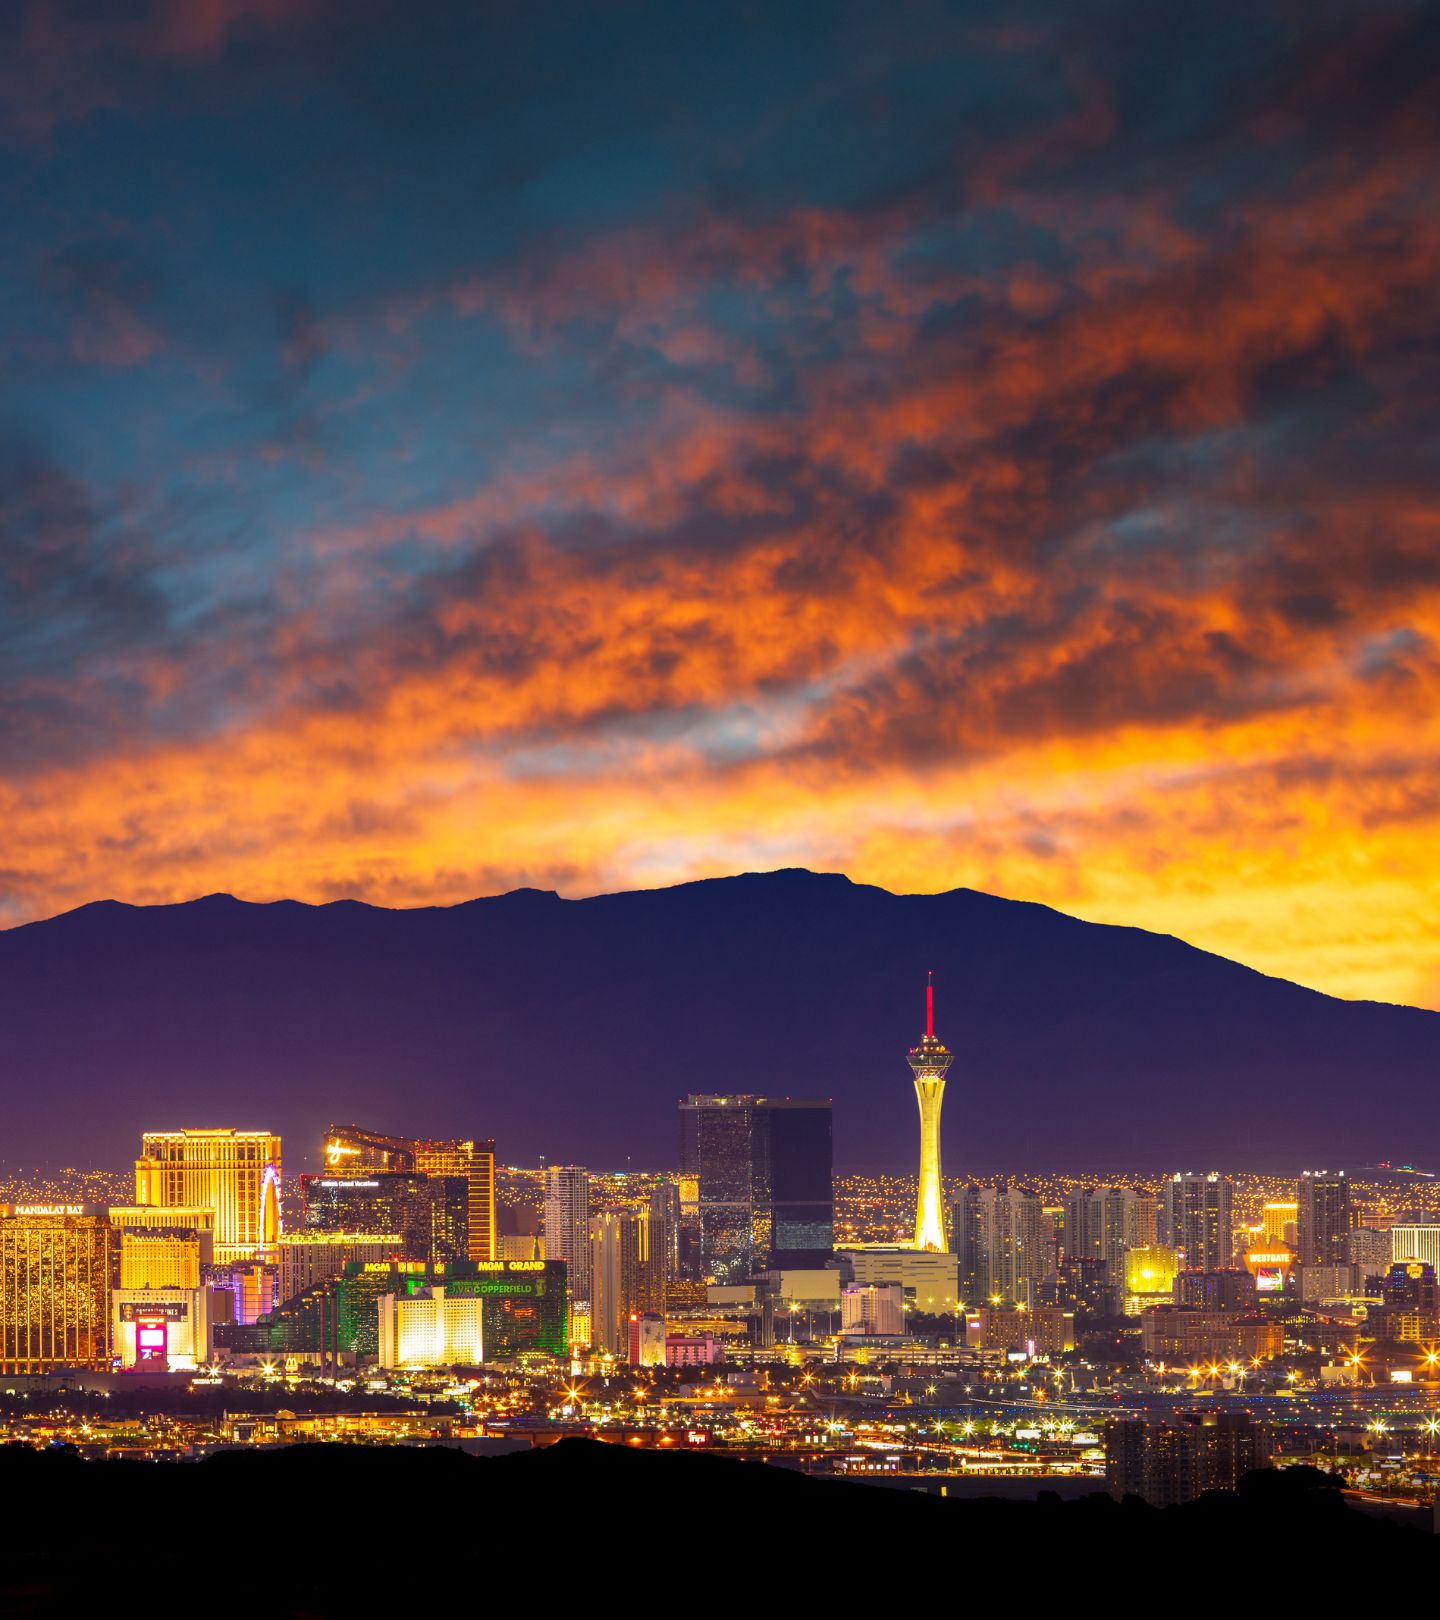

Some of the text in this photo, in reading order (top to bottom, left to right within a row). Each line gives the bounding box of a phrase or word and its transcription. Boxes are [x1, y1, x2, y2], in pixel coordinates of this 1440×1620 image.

[15, 1205, 84, 1215] MANDALAY BAY
[1249, 1253, 1290, 1262] WESTGATE
[364, 1263, 391, 1273] MGM
[478, 1261, 545, 1271] MGM GRAND
[473, 1285, 532, 1294] COPPERFIELD
